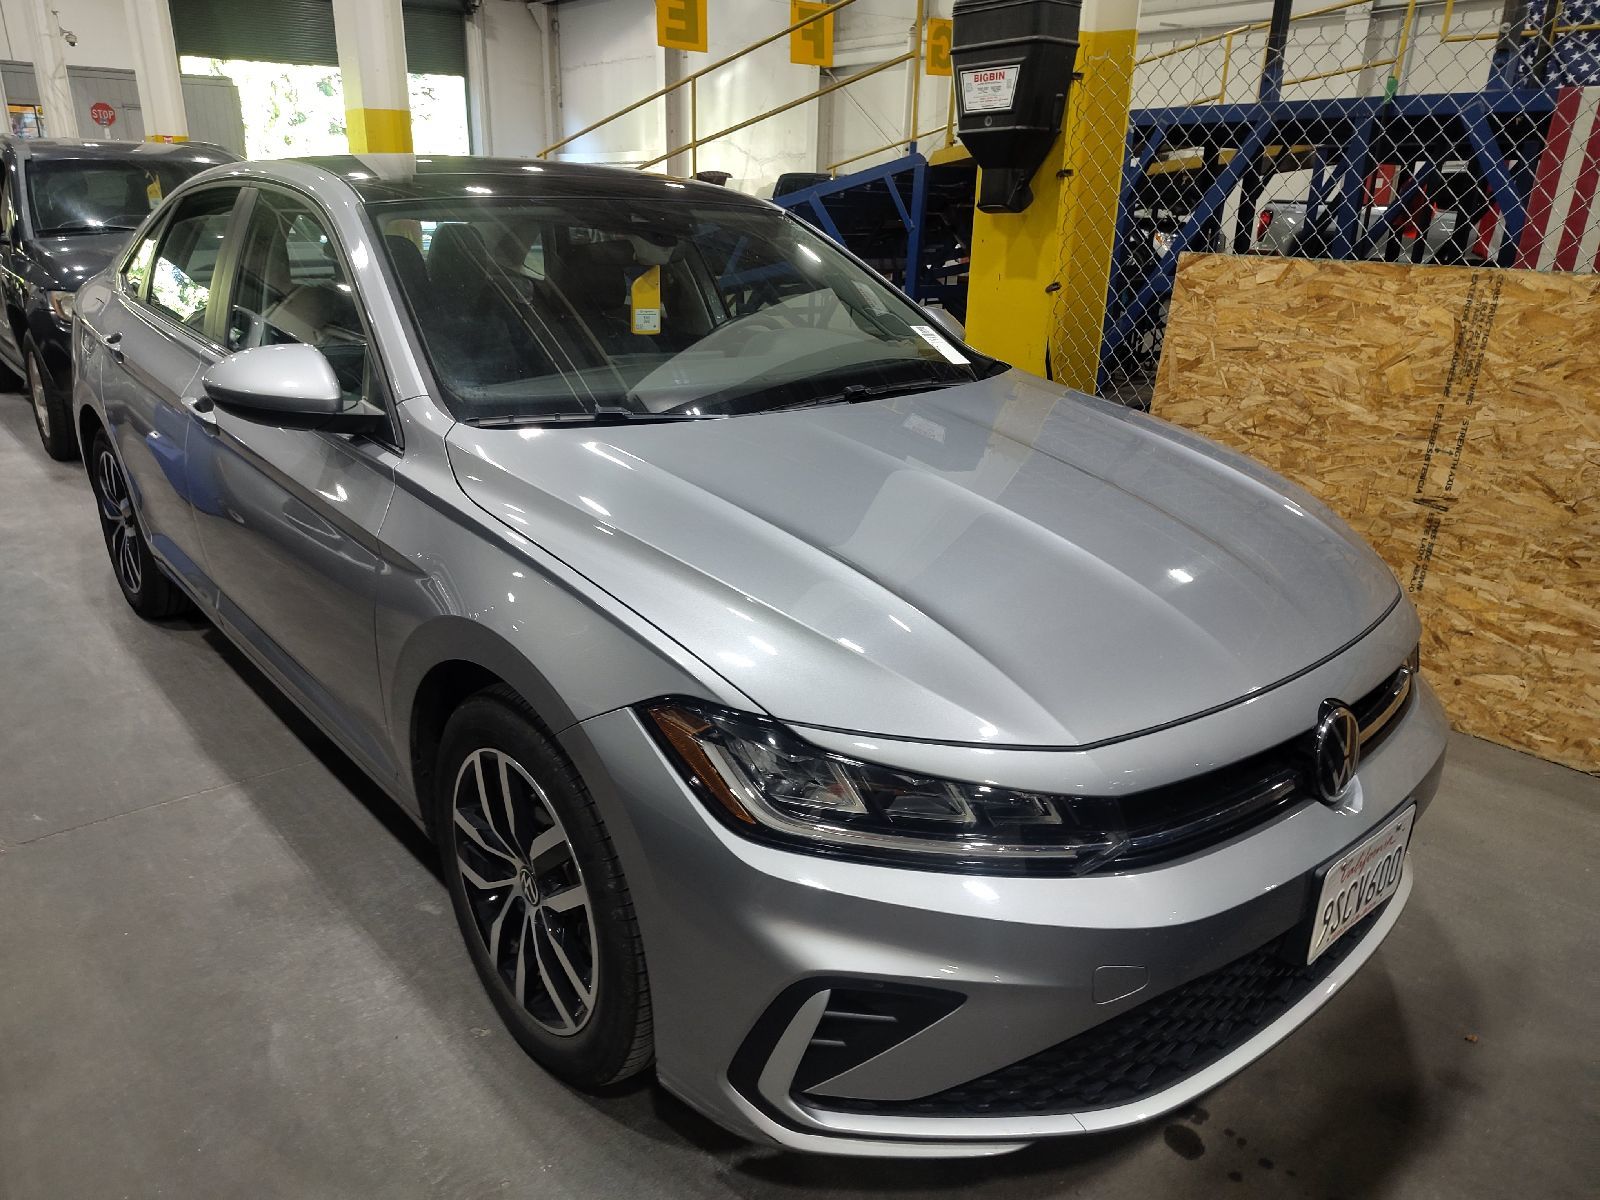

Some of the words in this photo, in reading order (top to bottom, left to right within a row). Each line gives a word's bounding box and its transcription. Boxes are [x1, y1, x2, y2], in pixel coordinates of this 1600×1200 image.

[974, 71, 1005, 82] BIGBIN
[92, 109, 114, 119] STOP
[1480, 273, 1504, 350] CONSTRUCTION
[1451, 419, 1469, 469] STRENGTH
[1445, 471, 1456, 491] AXIS
[1416, 563, 1428, 591] DOWN
[1315, 845, 1403, 948] 9SCV600
